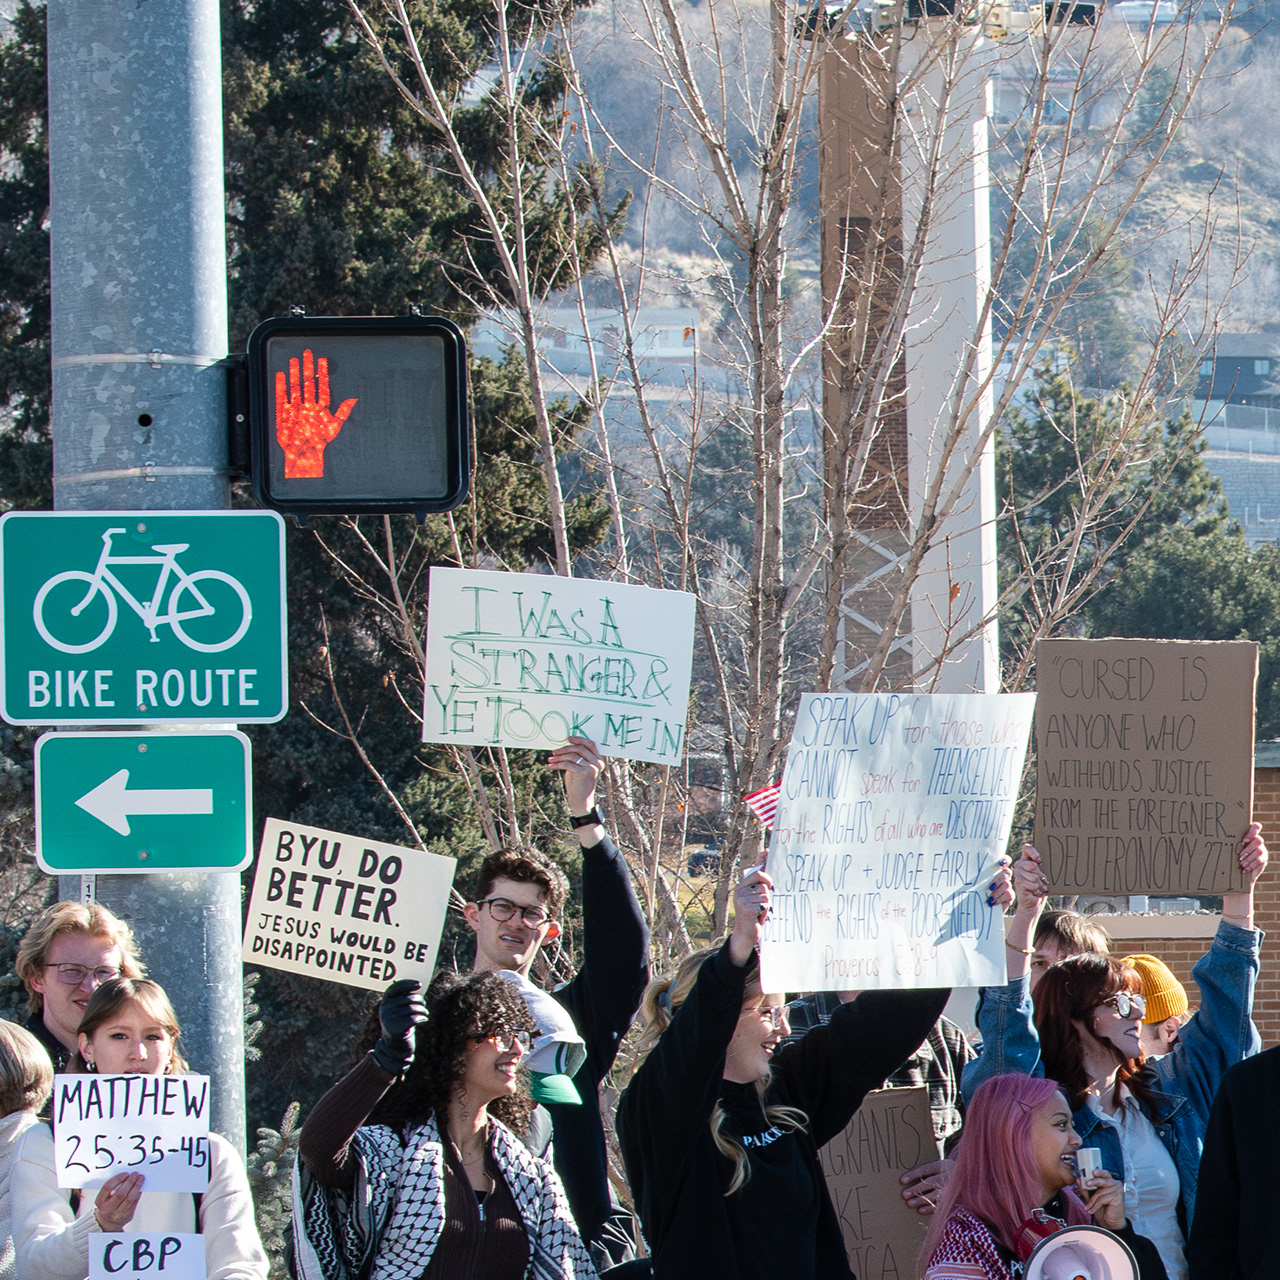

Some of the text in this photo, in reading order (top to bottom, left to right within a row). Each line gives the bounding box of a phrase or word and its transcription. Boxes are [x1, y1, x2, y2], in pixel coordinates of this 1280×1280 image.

[457, 586, 502, 636] I
[597, 596, 624, 649] A
[28, 669, 259, 708] BIKE ROUTE
[450, 641, 672, 706] STRANGER &
[1180, 656, 1208, 702] IS
[430, 684, 683, 758] YE TOOK ME IN
[803, 697, 868, 747] SPEAK
[869, 695, 901, 745] UP
[904, 698, 931, 744] for
[940, 701, 983, 746] those
[1046, 714, 1195, 751] ANYONE WHO
[786, 747, 1018, 801] CANNOT speak for THEMSELVES
[1045, 759, 1214, 797] WITHHOLDS JUSTICE
[775, 800, 1011, 844] for the RIGHTS of all who are DESTITUTE
[1042, 797, 1119, 830] FROM THE
[276, 831, 402, 885] BYU, DO
[785, 850, 989, 892] SPEAK UP + JUDGE FAIRLY
[1047, 835, 1197, 892] DEUTERONOMY
[266, 867, 400, 928] BETTER.
[817, 904, 830, 919] the
[837, 892, 881, 940] RIGHTS
[893, 902, 906, 917] the
[910, 892, 945, 939] POOR
[951, 890, 994, 941] NEEDY
[258, 913, 429, 963] JESUS WOULD BE
[58, 1076, 208, 1124] MATTHEW
[64, 1134, 208, 1173] 25:35-45
[102, 1237, 182, 1273] CBP
